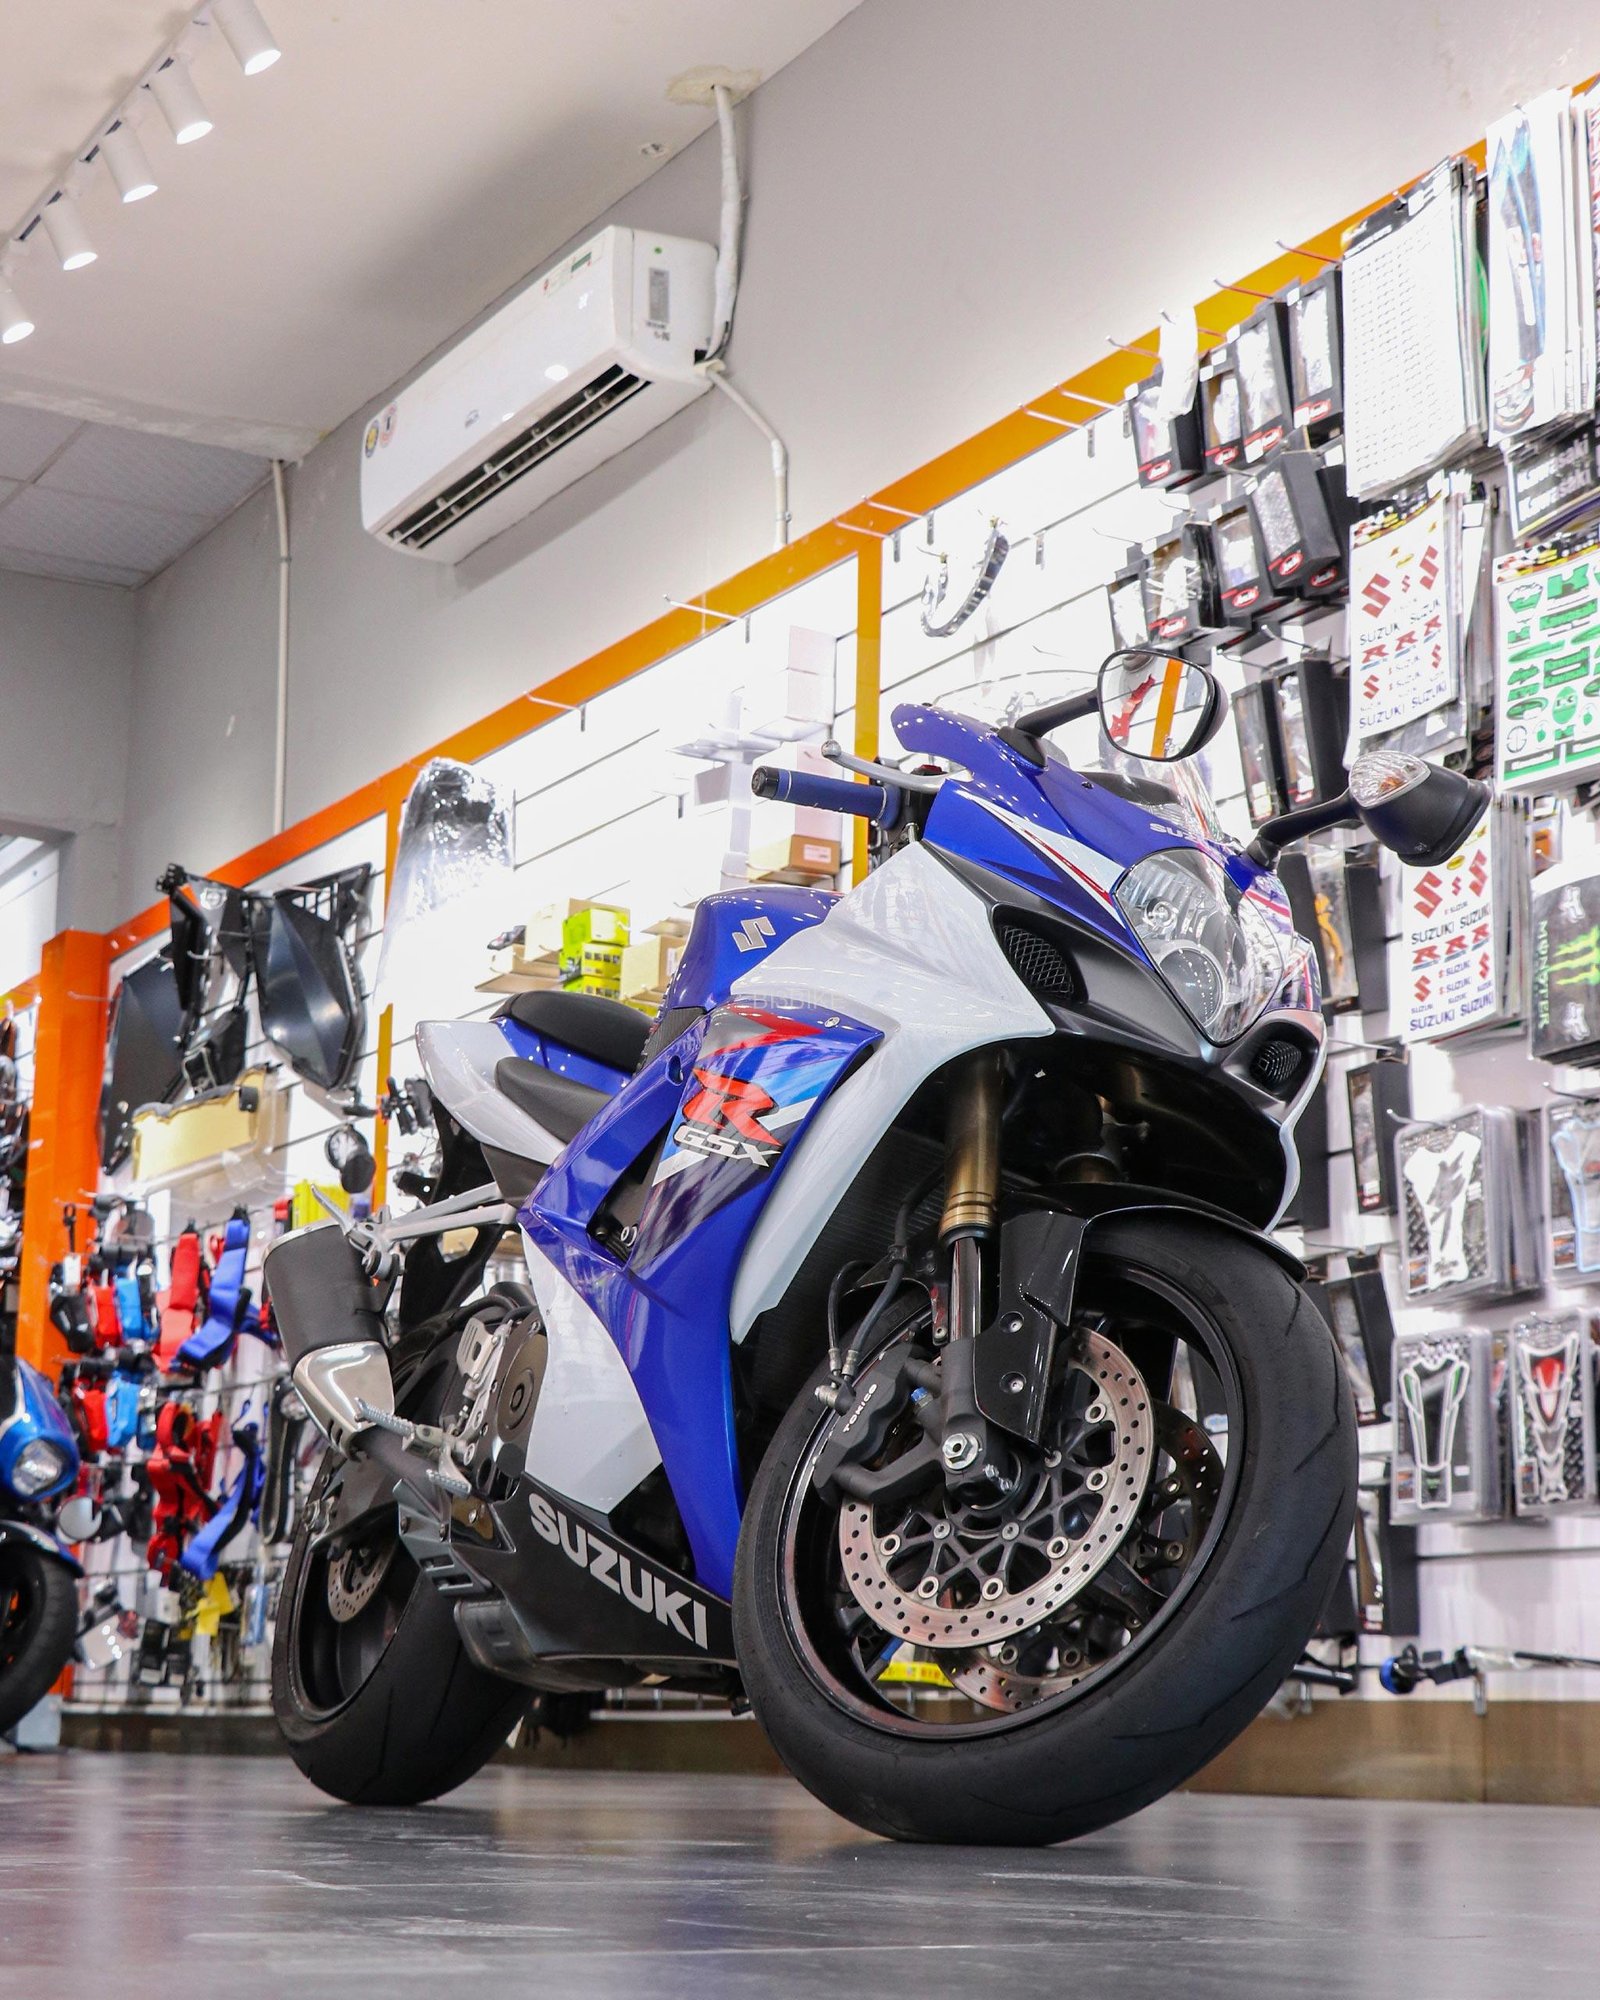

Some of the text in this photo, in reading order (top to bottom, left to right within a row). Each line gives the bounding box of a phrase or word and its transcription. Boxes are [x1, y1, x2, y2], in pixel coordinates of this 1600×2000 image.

[1360, 623, 1400, 646] SUZUK
[1359, 704, 1405, 729] SUZUKI
[1149, 822, 1198, 841] SUZ
[1411, 921, 1455, 945] SUZUKI
[1446, 960, 1471, 976] SUZUK
[1446, 977, 1472, 992] SUZUK
[1410, 1009, 1456, 1031] SUZUKI
[1411, 1003, 1434, 1014] SUZUK
[673, 1124, 782, 1168] GSX
[842, 1383, 878, 1433] TOKICO
[527, 1493, 709, 1650] SUZUKI
